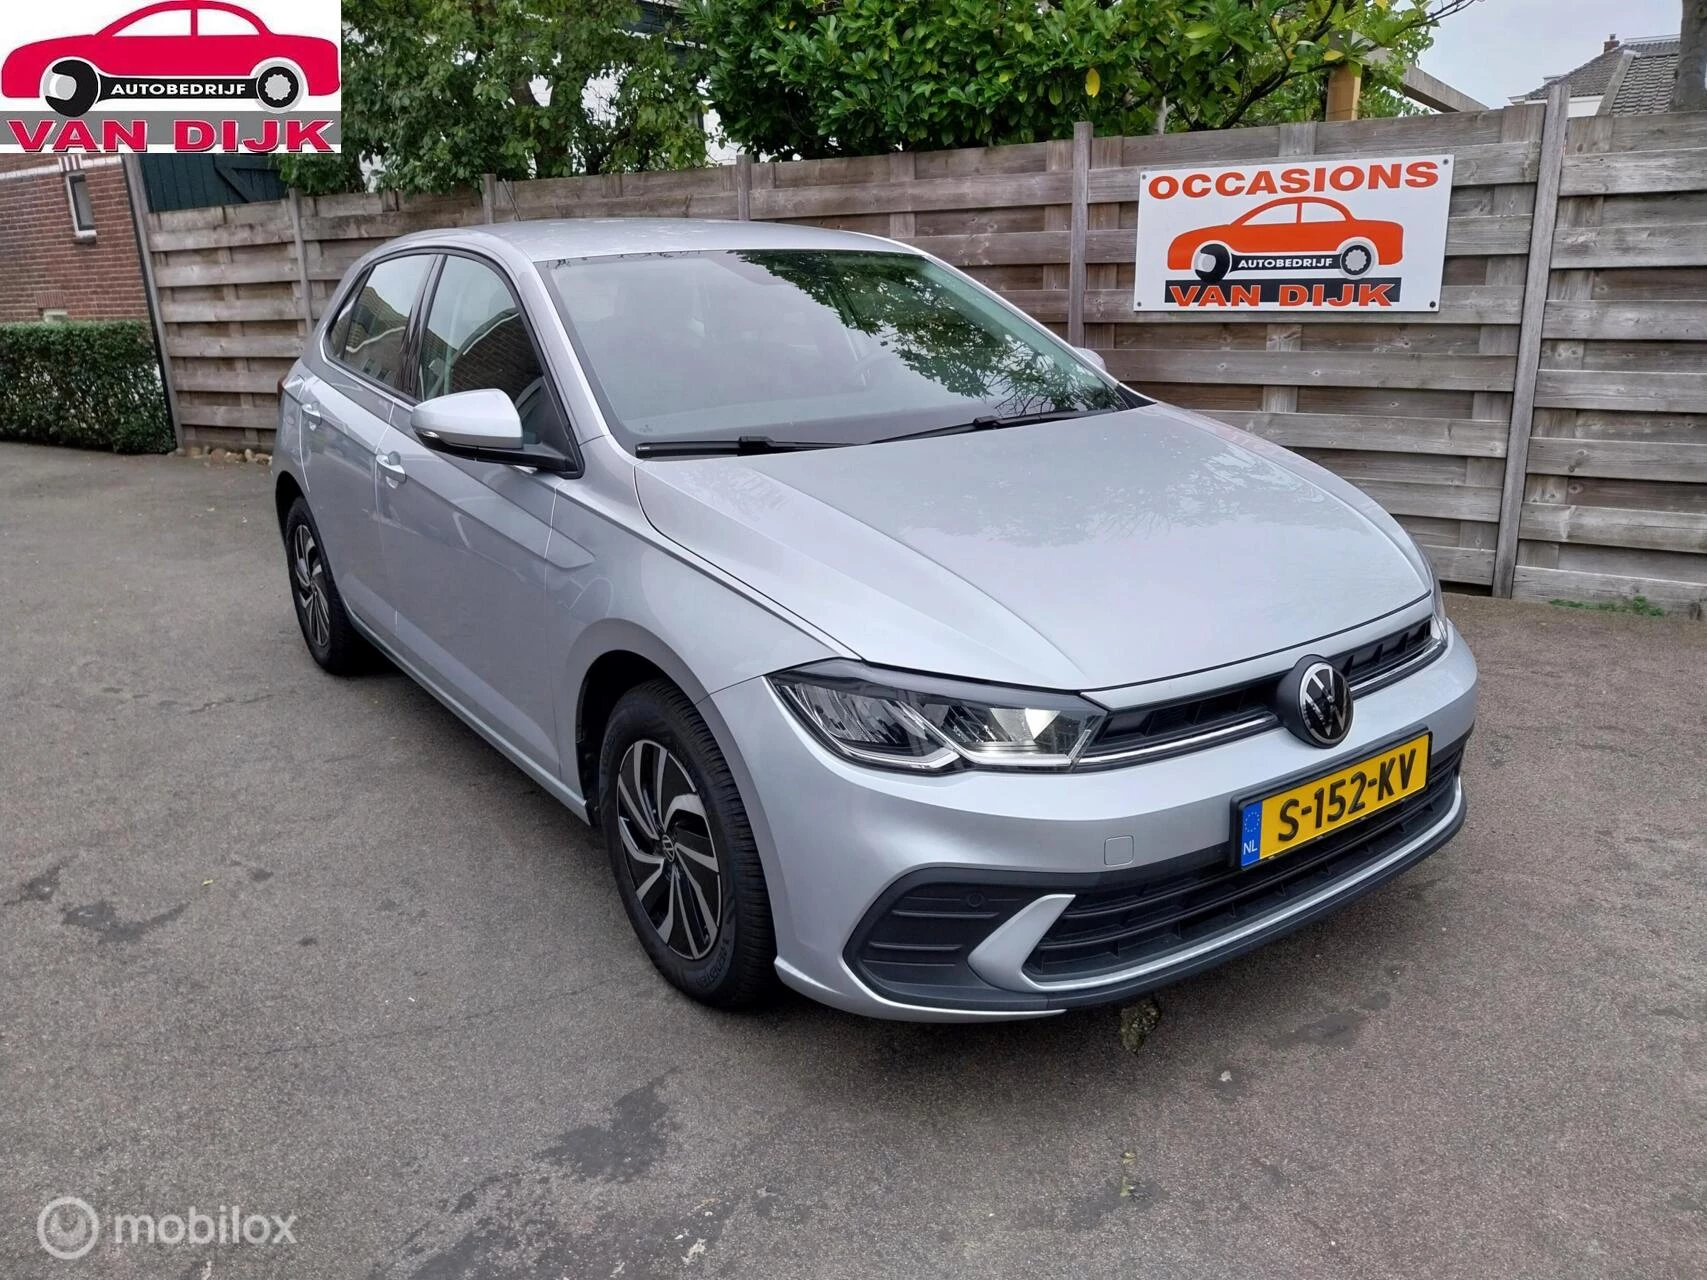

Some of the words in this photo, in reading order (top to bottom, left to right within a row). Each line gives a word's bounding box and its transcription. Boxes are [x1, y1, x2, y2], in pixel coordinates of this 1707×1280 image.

[1148, 161, 1439, 199] OCCASIONS
[1238, 258, 1333, 269] AUTOBEDRIJF
[1170, 285, 1261, 307] VAN
[1279, 283, 1394, 307] DIJK
[1278, 748, 1417, 842] S-152-KV
[1243, 839, 1258, 856] NL
